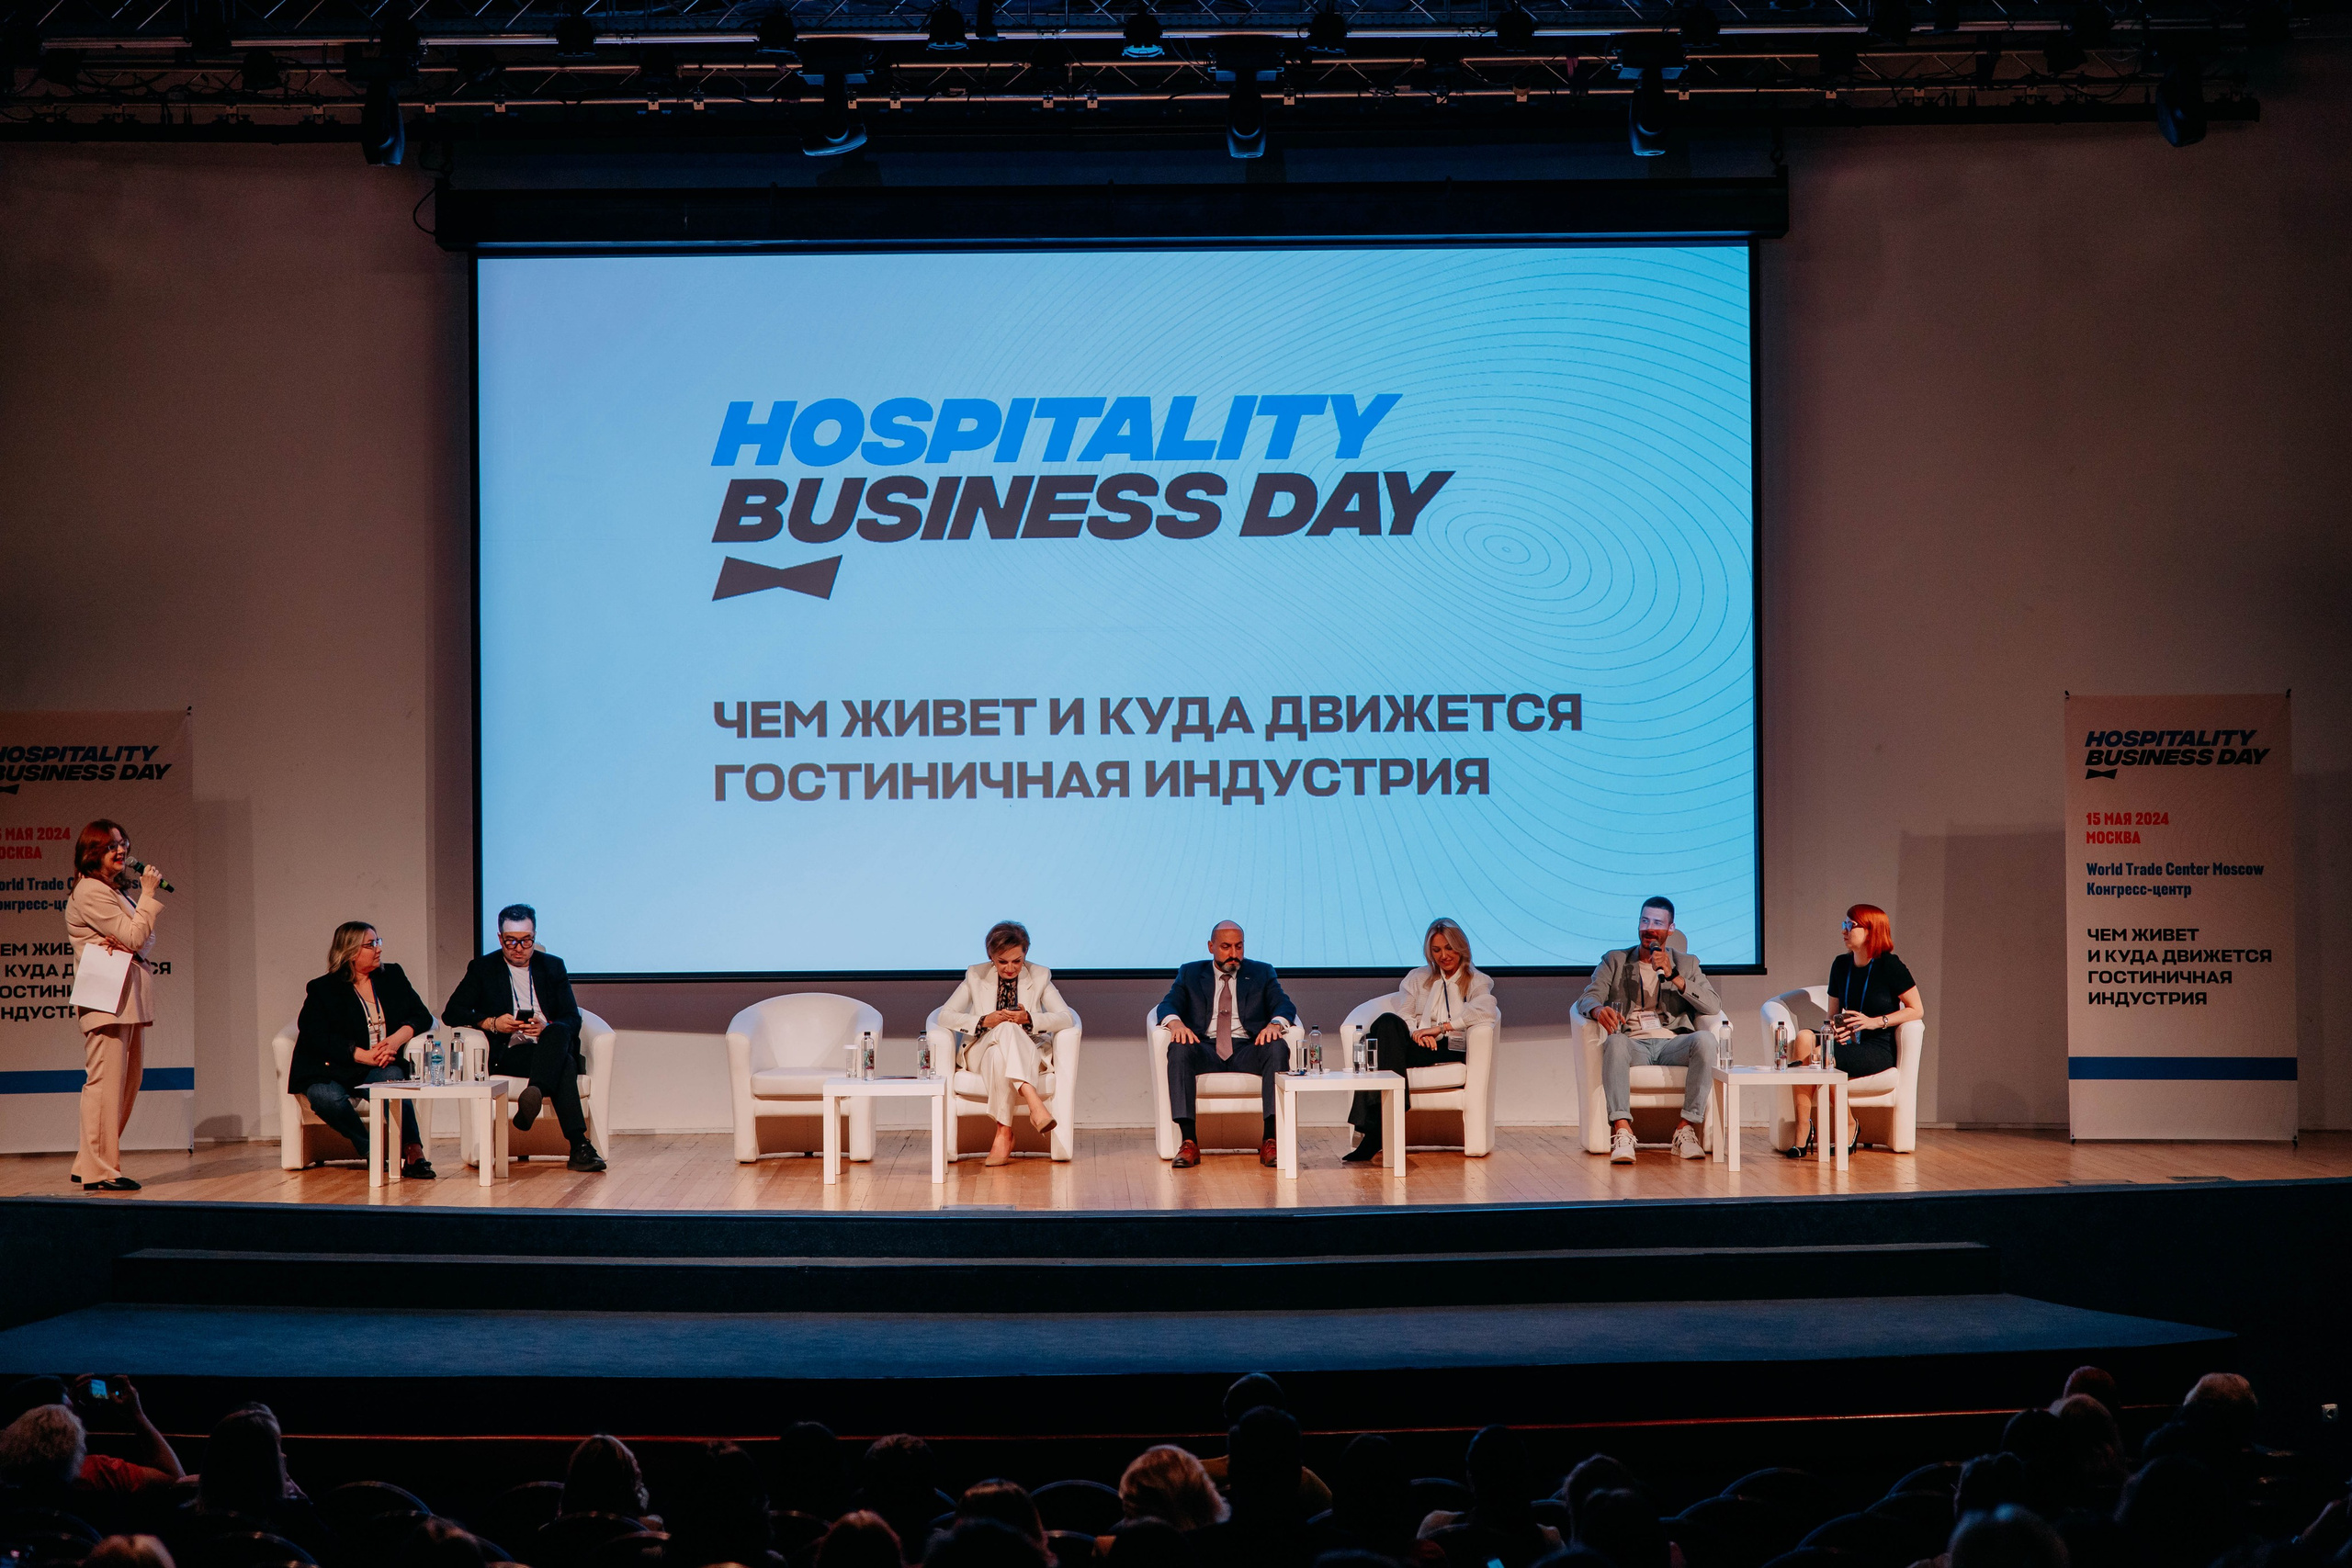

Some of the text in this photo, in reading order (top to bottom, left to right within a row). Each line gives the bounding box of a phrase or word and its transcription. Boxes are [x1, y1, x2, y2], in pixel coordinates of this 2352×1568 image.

[711, 393, 1403, 467] HOSPITALITY
[712, 469, 1456, 544] BUSINESS DAY
[715, 693, 1582, 742] ЧЕМ ЖИВЕТ И КУДА ДВИЖЕТСЯ
[2086, 729, 2257, 747] HOSPITALITY
[2086, 749, 2270, 765] BUSINESS DAY
[119, 764, 172, 780] DAY
[715, 758, 1489, 805] ГОСТИНИЧНАЯ ИНДУСТРИЯ
[2086, 812, 2169, 825] 15 МАЯ 2024
[6, 828, 33, 840] МАЯ
[37, 827, 71, 840] 2024
[2086, 831, 2141, 844] МОСКВА
[0, 846, 42, 859] ОСКВА
[2086, 863, 2264, 875] World Trade Center Moscow
[0, 878, 24, 891] orld
[27, 877, 63, 890] Trade
[2087, 883, 2191, 898] Конгресс-центр
[2087, 929, 2199, 941] ЧЕМ ЖИВЕТ
[1, 942, 74, 956] ЕМ ЖИВ
[2088, 949, 2272, 964] И КУДА ДВИЖЕТСЯ
[6, 964, 58, 979] КУДА
[2088, 971, 2232, 984] ГОСТИНИЧНАЯ
[2089, 992, 2207, 1007] ИНДУСТРИЯ
